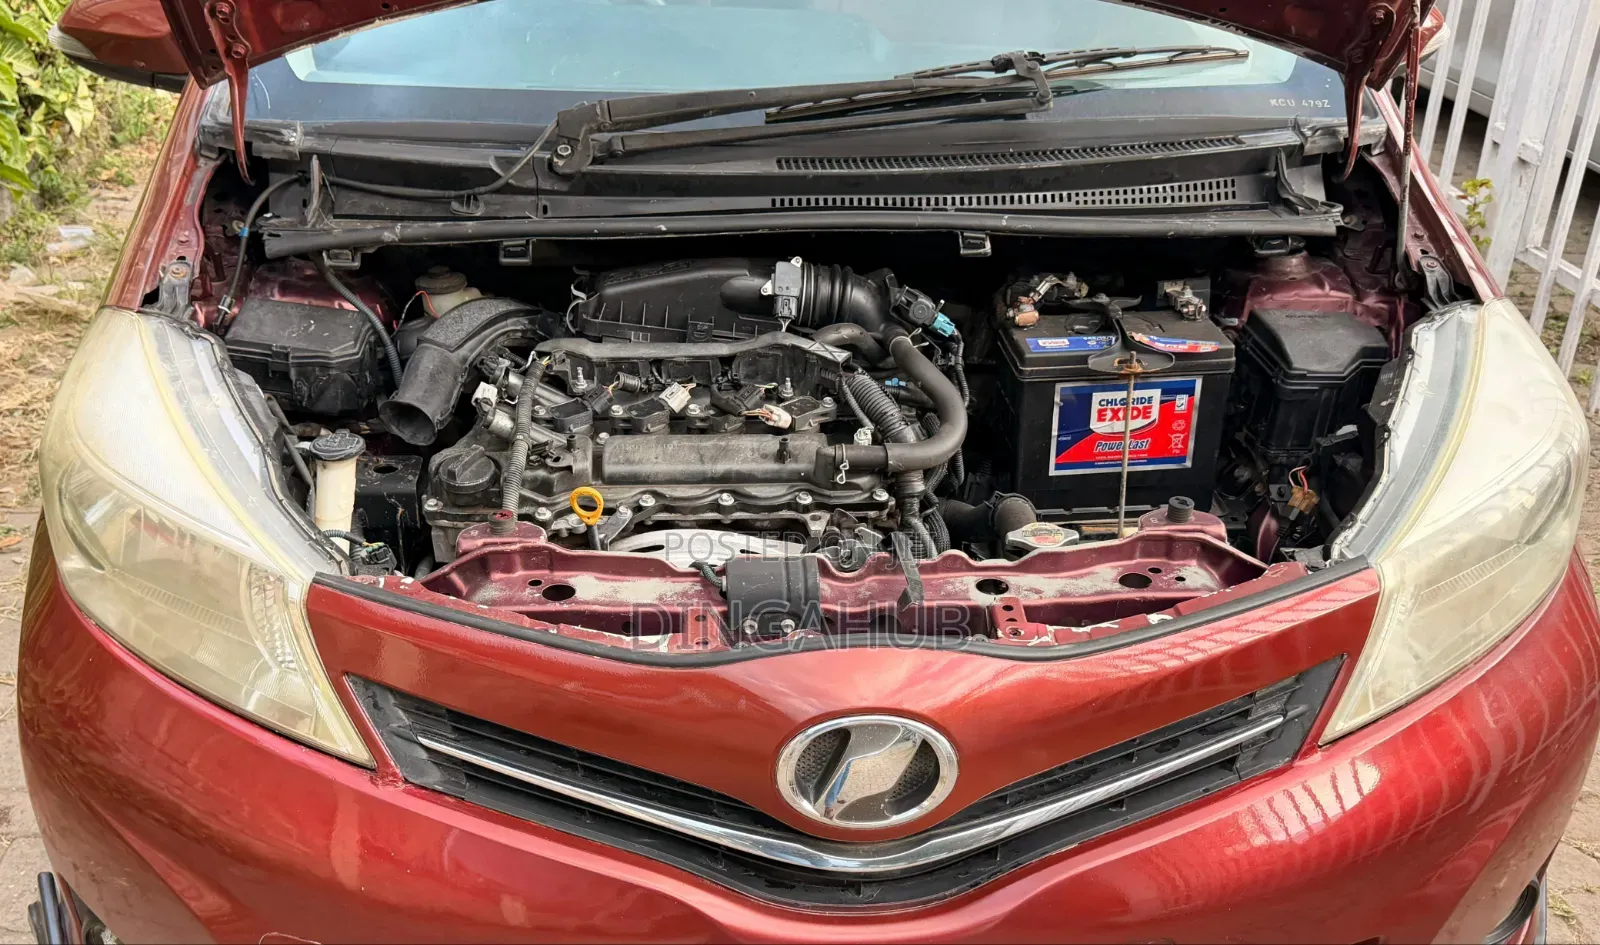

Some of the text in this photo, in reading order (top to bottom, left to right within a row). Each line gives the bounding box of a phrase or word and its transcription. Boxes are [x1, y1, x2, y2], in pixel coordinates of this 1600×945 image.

[1269, 98, 1331, 108] KCU 479Z
[1098, 395, 1154, 407] CHLORIDE
[1096, 405, 1154, 423] EXIDE
